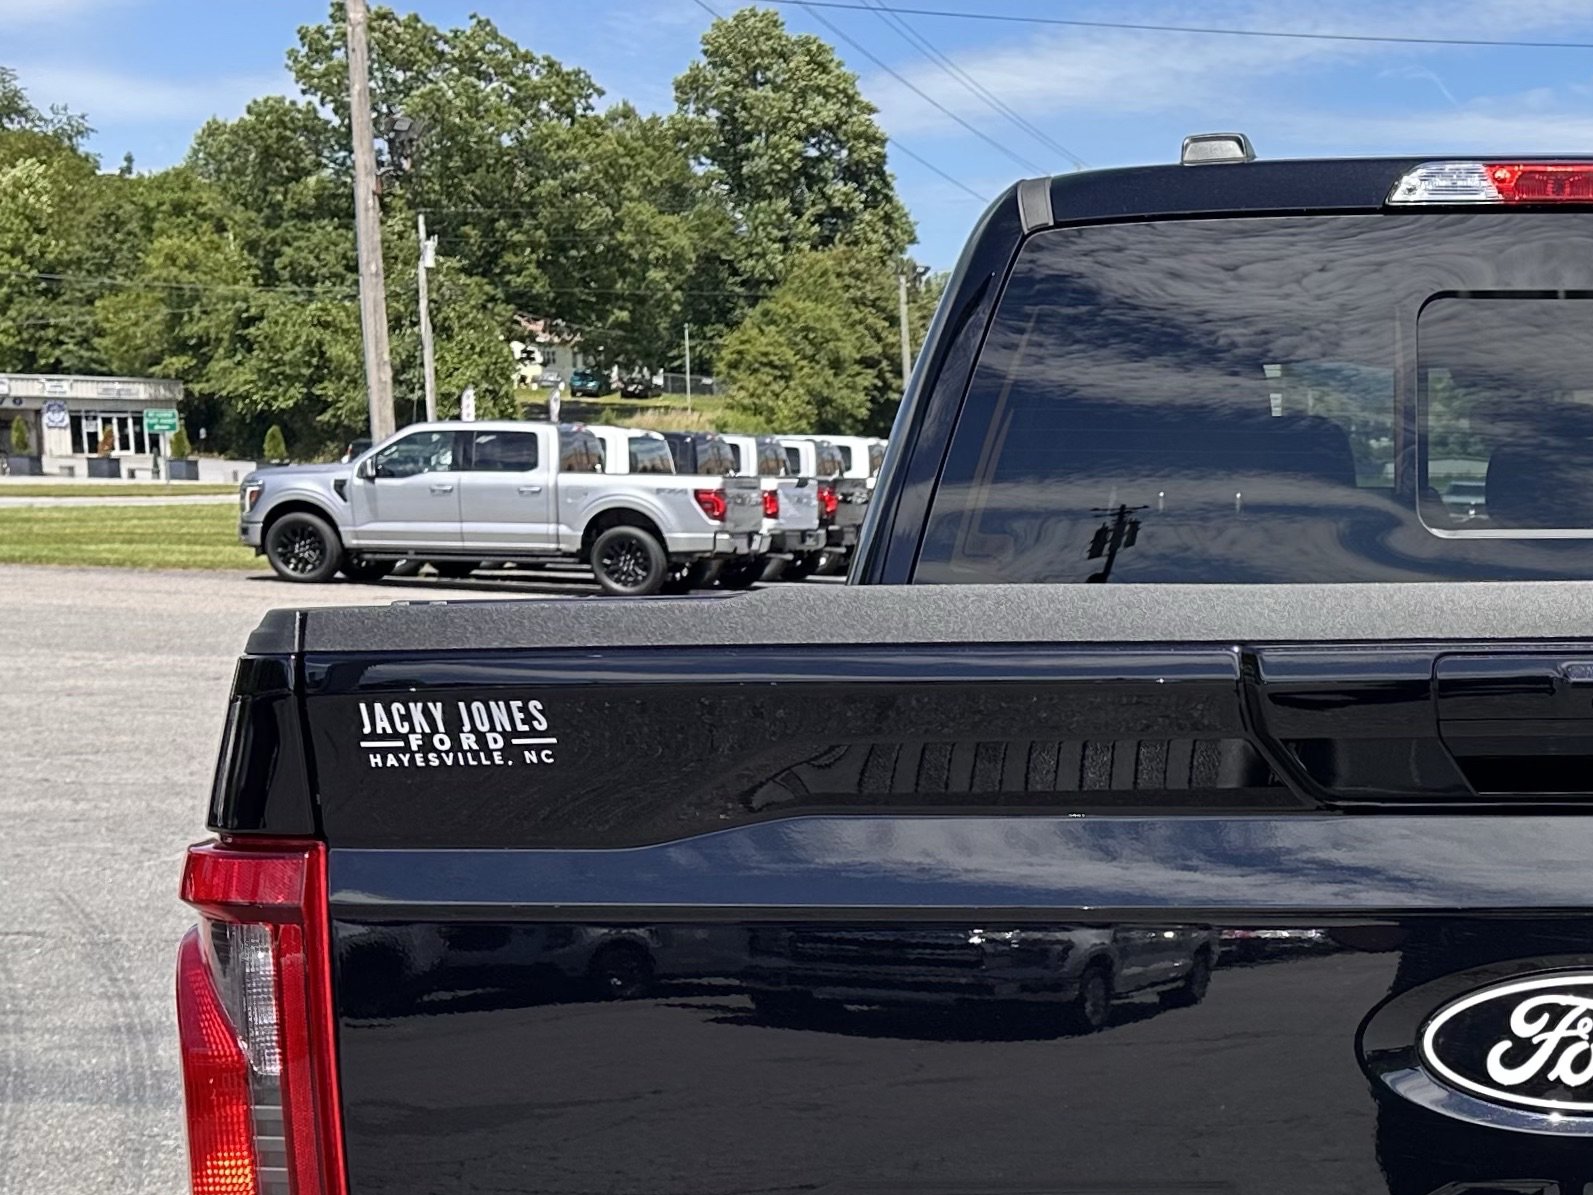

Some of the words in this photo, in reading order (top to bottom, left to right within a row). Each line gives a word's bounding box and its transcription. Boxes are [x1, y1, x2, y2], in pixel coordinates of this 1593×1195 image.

[358, 701, 446, 735] JACKY
[457, 699, 548, 733] JONES
[407, 732, 505, 751] FORD
[368, 751, 514, 768] HAYESVILLE,
[523, 749, 555, 764] NC
